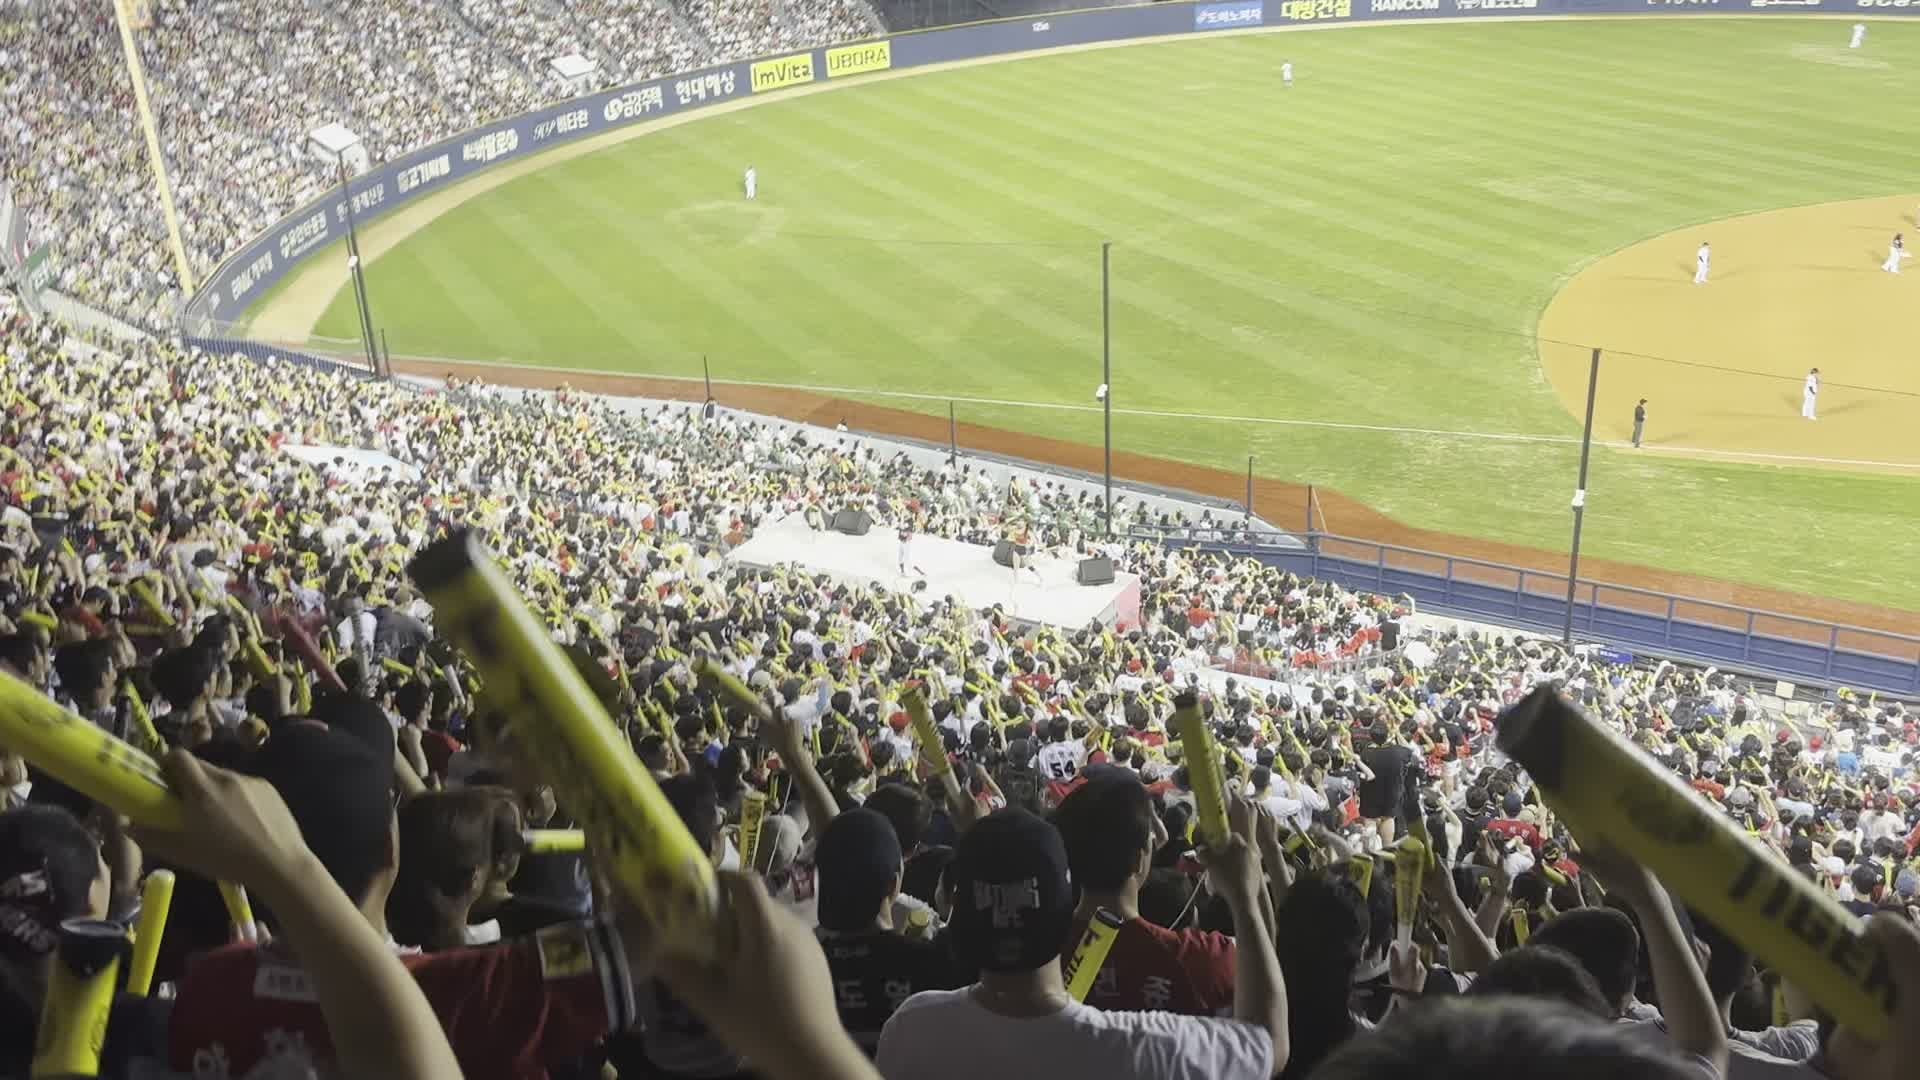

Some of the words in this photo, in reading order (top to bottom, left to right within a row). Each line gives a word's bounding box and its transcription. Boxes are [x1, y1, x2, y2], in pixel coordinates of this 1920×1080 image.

[829, 47, 888, 70] UBORA
[753, 62, 811, 87] ImVita
[674, 70, 736, 105] 현대해상
[1049, 759, 1075, 778] 54
